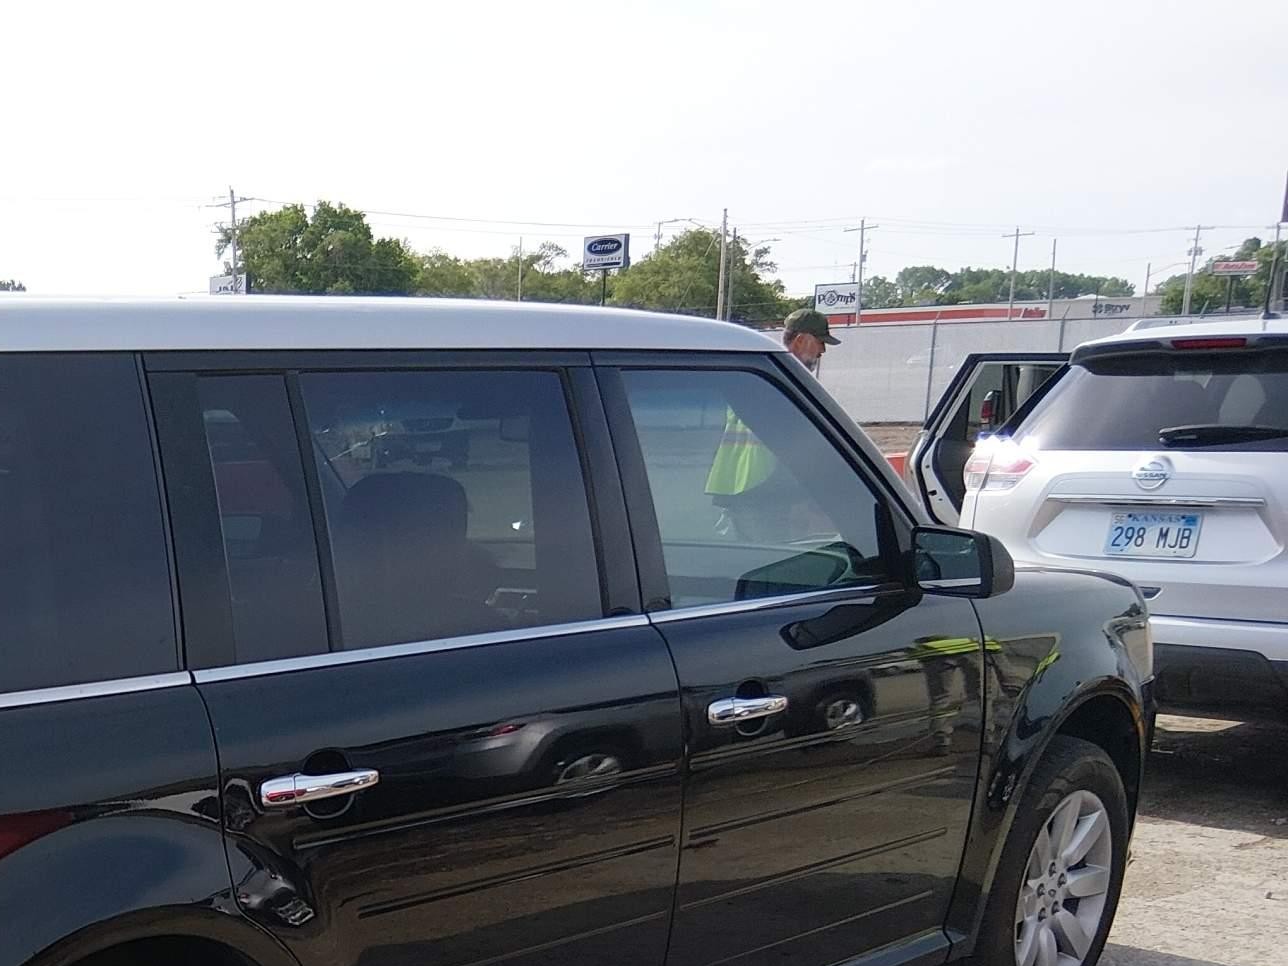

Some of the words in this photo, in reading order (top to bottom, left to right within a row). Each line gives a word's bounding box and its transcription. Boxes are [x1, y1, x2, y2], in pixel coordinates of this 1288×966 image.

[591, 241, 618, 252] Carrier
[1131, 513, 1182, 523] KANSAS
[1111, 526, 1146, 548] 298
[1155, 527, 1192, 549] MJB
